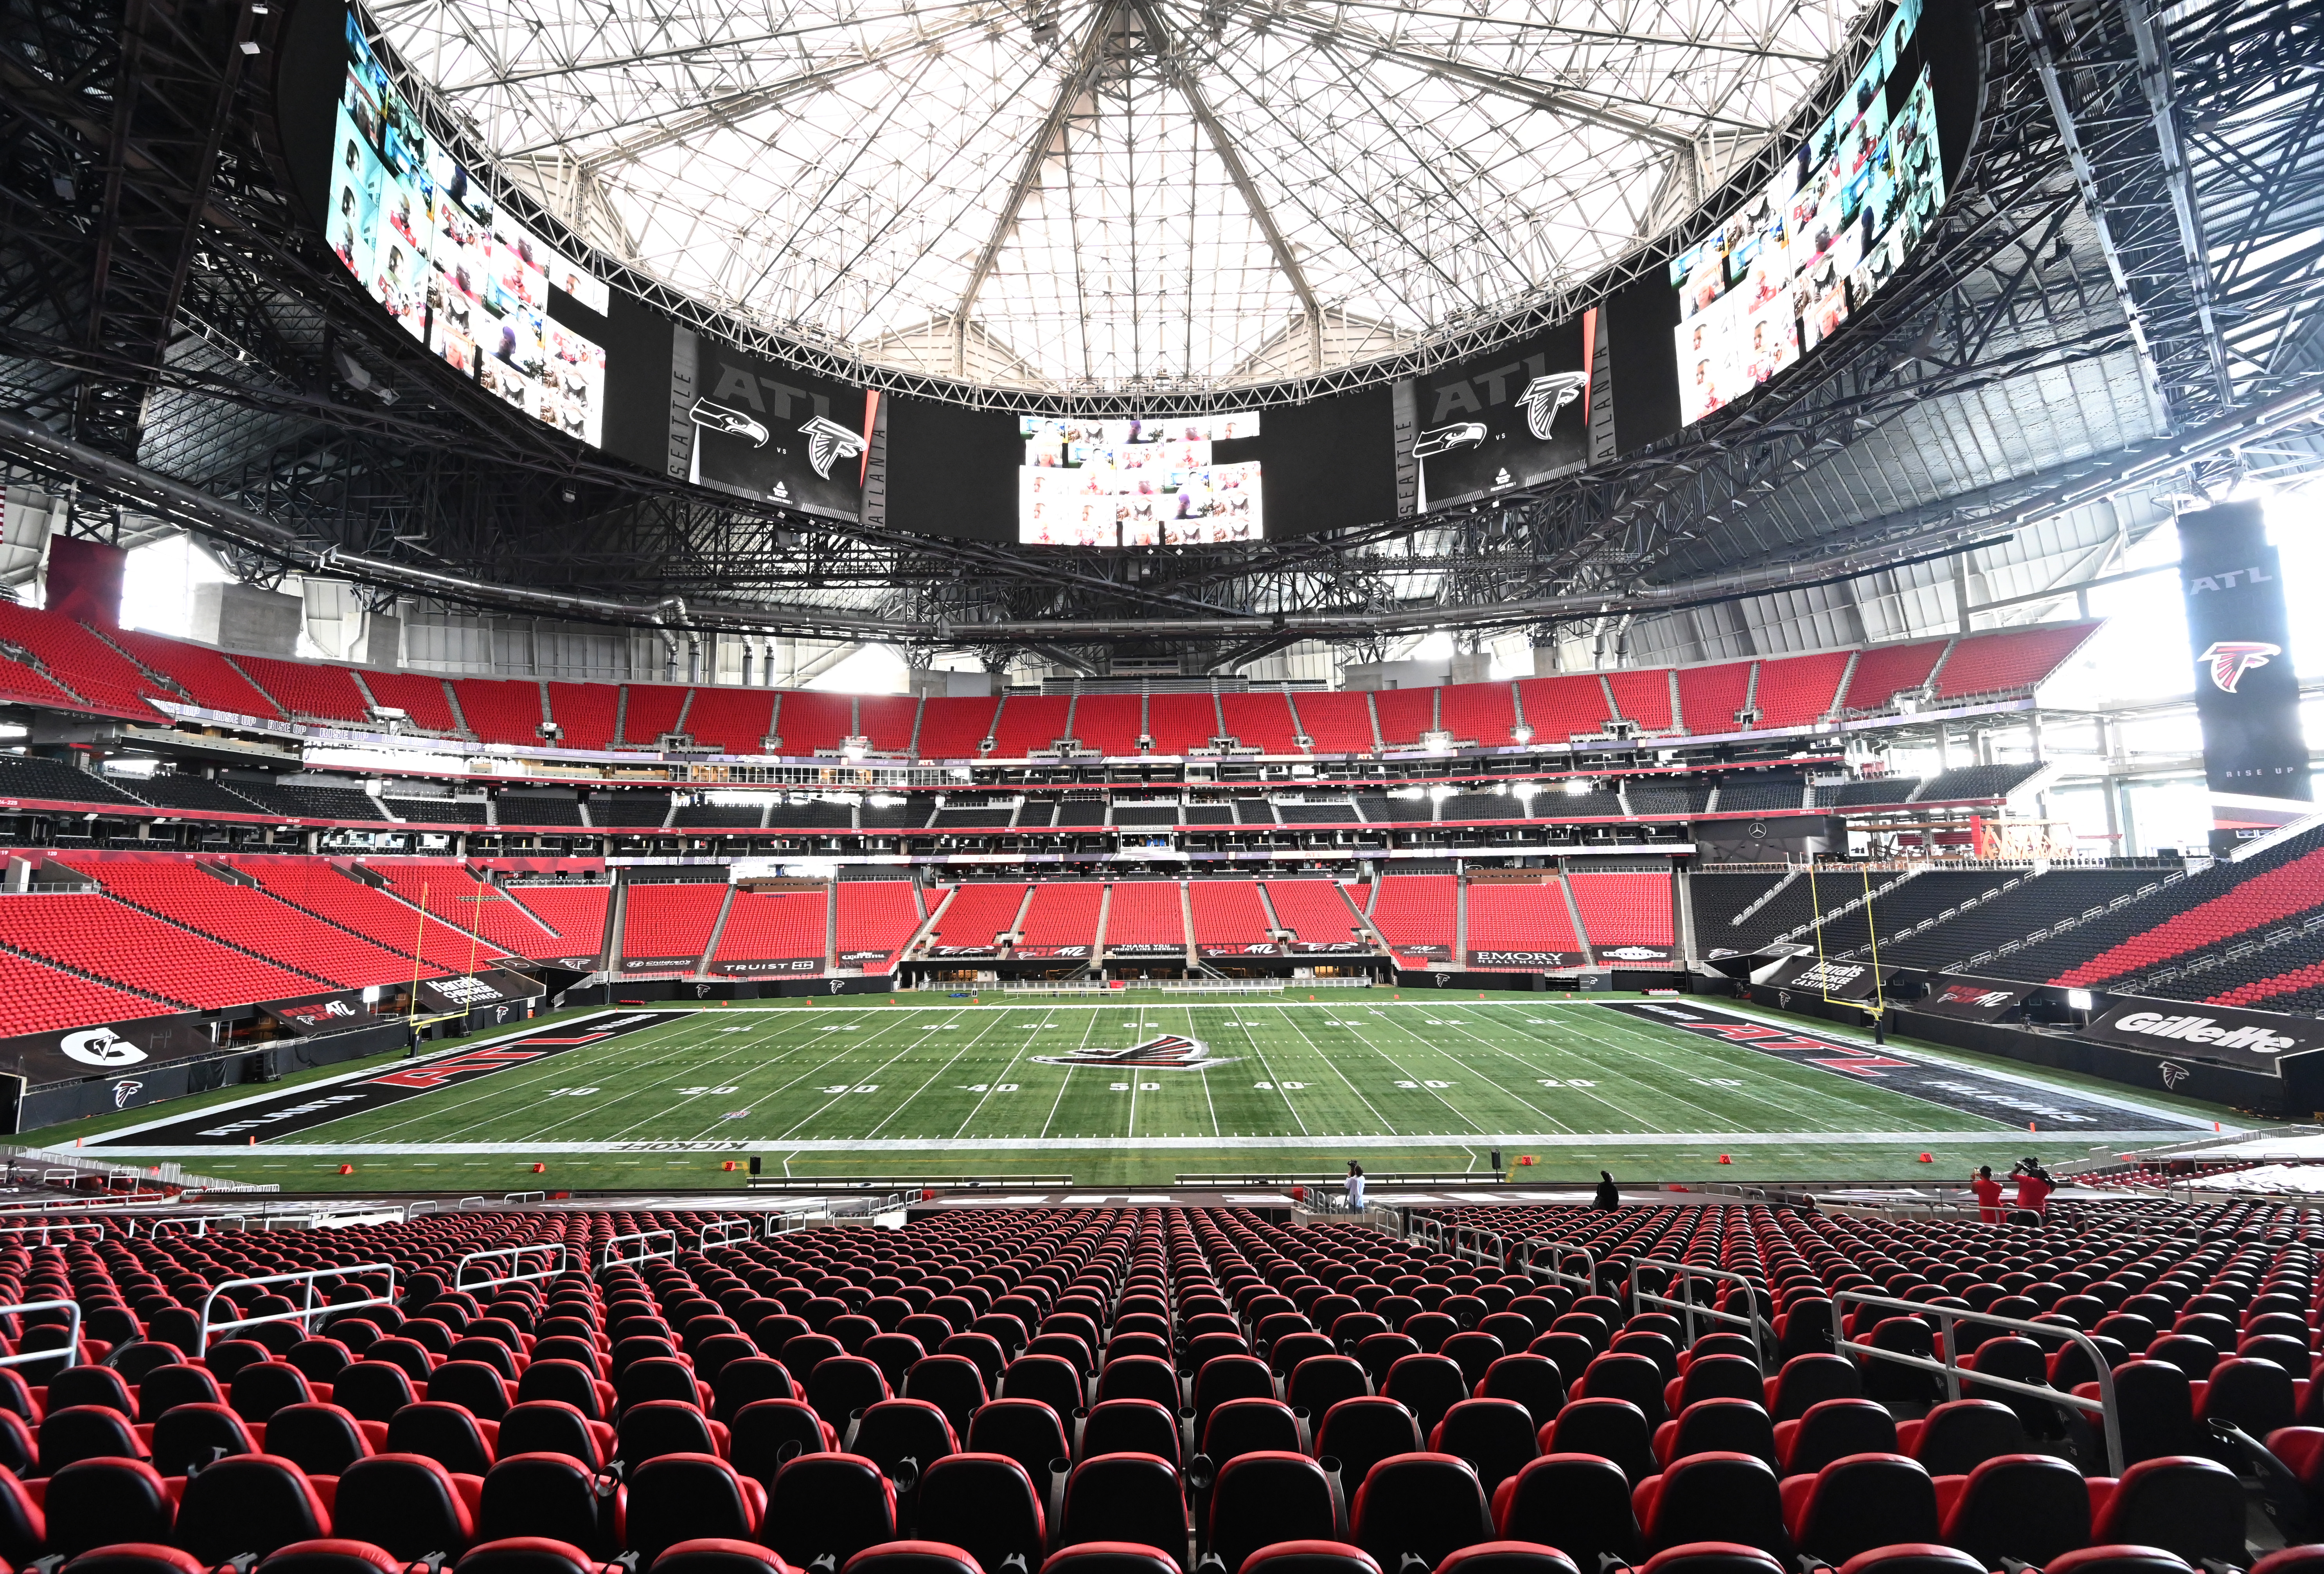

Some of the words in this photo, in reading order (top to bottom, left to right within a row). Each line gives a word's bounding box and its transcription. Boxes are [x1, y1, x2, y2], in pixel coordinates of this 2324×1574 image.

[1592, 346, 1614, 460] ATLANTA
[670, 370, 691, 478] SEATTLE
[1396, 421, 1415, 515] SEATTLE
[868, 429, 885, 525] ATLANTA
[2191, 567, 2272, 595] ATL
[183, 705, 200, 717] UP
[1966, 703, 1995, 715] RISE
[1998, 701, 2018, 712] UP
[213, 710, 239, 724] RISE
[241, 715, 256, 726] UP
[1903, 712, 1931, 723] RISE
[1934, 709, 1951, 721] UP
[268, 720, 290, 733] RISE
[293, 724, 306, 735] UP
[1817, 723, 1831, 732] UP
[1846, 719, 1871, 730] RISE
[1874, 717, 1889, 728] UP
[320, 728, 349, 739] RISE
[352, 731, 368, 741] UP
[382, 734, 408, 745] RISE
[412, 737, 427, 746] UP
[439, 740, 463, 750] RISE
[466, 742, 482, 751] UP
[2226, 769, 2262, 778] RISE
[644, 857, 666, 865] RISE
[669, 857, 684, 865] UP
[694, 857, 716, 865] RISE
[719, 857, 731, 865] UP
[1054, 946, 1087, 957] ATL
[1244, 943, 1277, 955] ATL
[1477, 951, 1564, 961] EMORY
[724, 963, 789, 971] TRUIST
[1808, 961, 1865, 977] Harrah's
[426, 976, 485, 992] Harrah's
[1791, 978, 1842, 991] CASINOS
[1801, 972, 1853, 985] CHEROKEE
[443, 985, 495, 998] CHEROKEE
[453, 991, 503, 1004] CASINOS
[1973, 991, 2013, 1007] ATL
[280, 1004, 327, 1017] RISE
[325, 1000, 356, 1016] ATL
[1633, 1004, 1704, 1020] ATLANTA
[586, 1014, 659, 1031] FALCONS
[2115, 1012, 2295, 1053] Gillette
[61, 1027, 149, 1066] G
[1674, 1022, 1920, 1077] ATL
[341, 1031, 616, 1089] ATL
[967, 1083, 1019, 1092] 40
[1109, 1082, 1160, 1091] 50
[1253, 1081, 1305, 1090] 40
[1394, 1080, 1450, 1089] 30
[1537, 1078, 1596, 1087] 20
[1688, 1078, 1742, 1086] 10
[549, 1087, 600, 1096] 10
[679, 1086, 740, 1095] 20
[823, 1085, 880, 1094] 30
[1921, 1081, 2098, 1122] FALCONS
[196, 1094, 368, 1136] ATLANTA
[609, 1142, 751, 1151] KICKOFF
[1523, 1157, 1531, 1165] 30
[1722, 1155, 1731, 1164] 20
